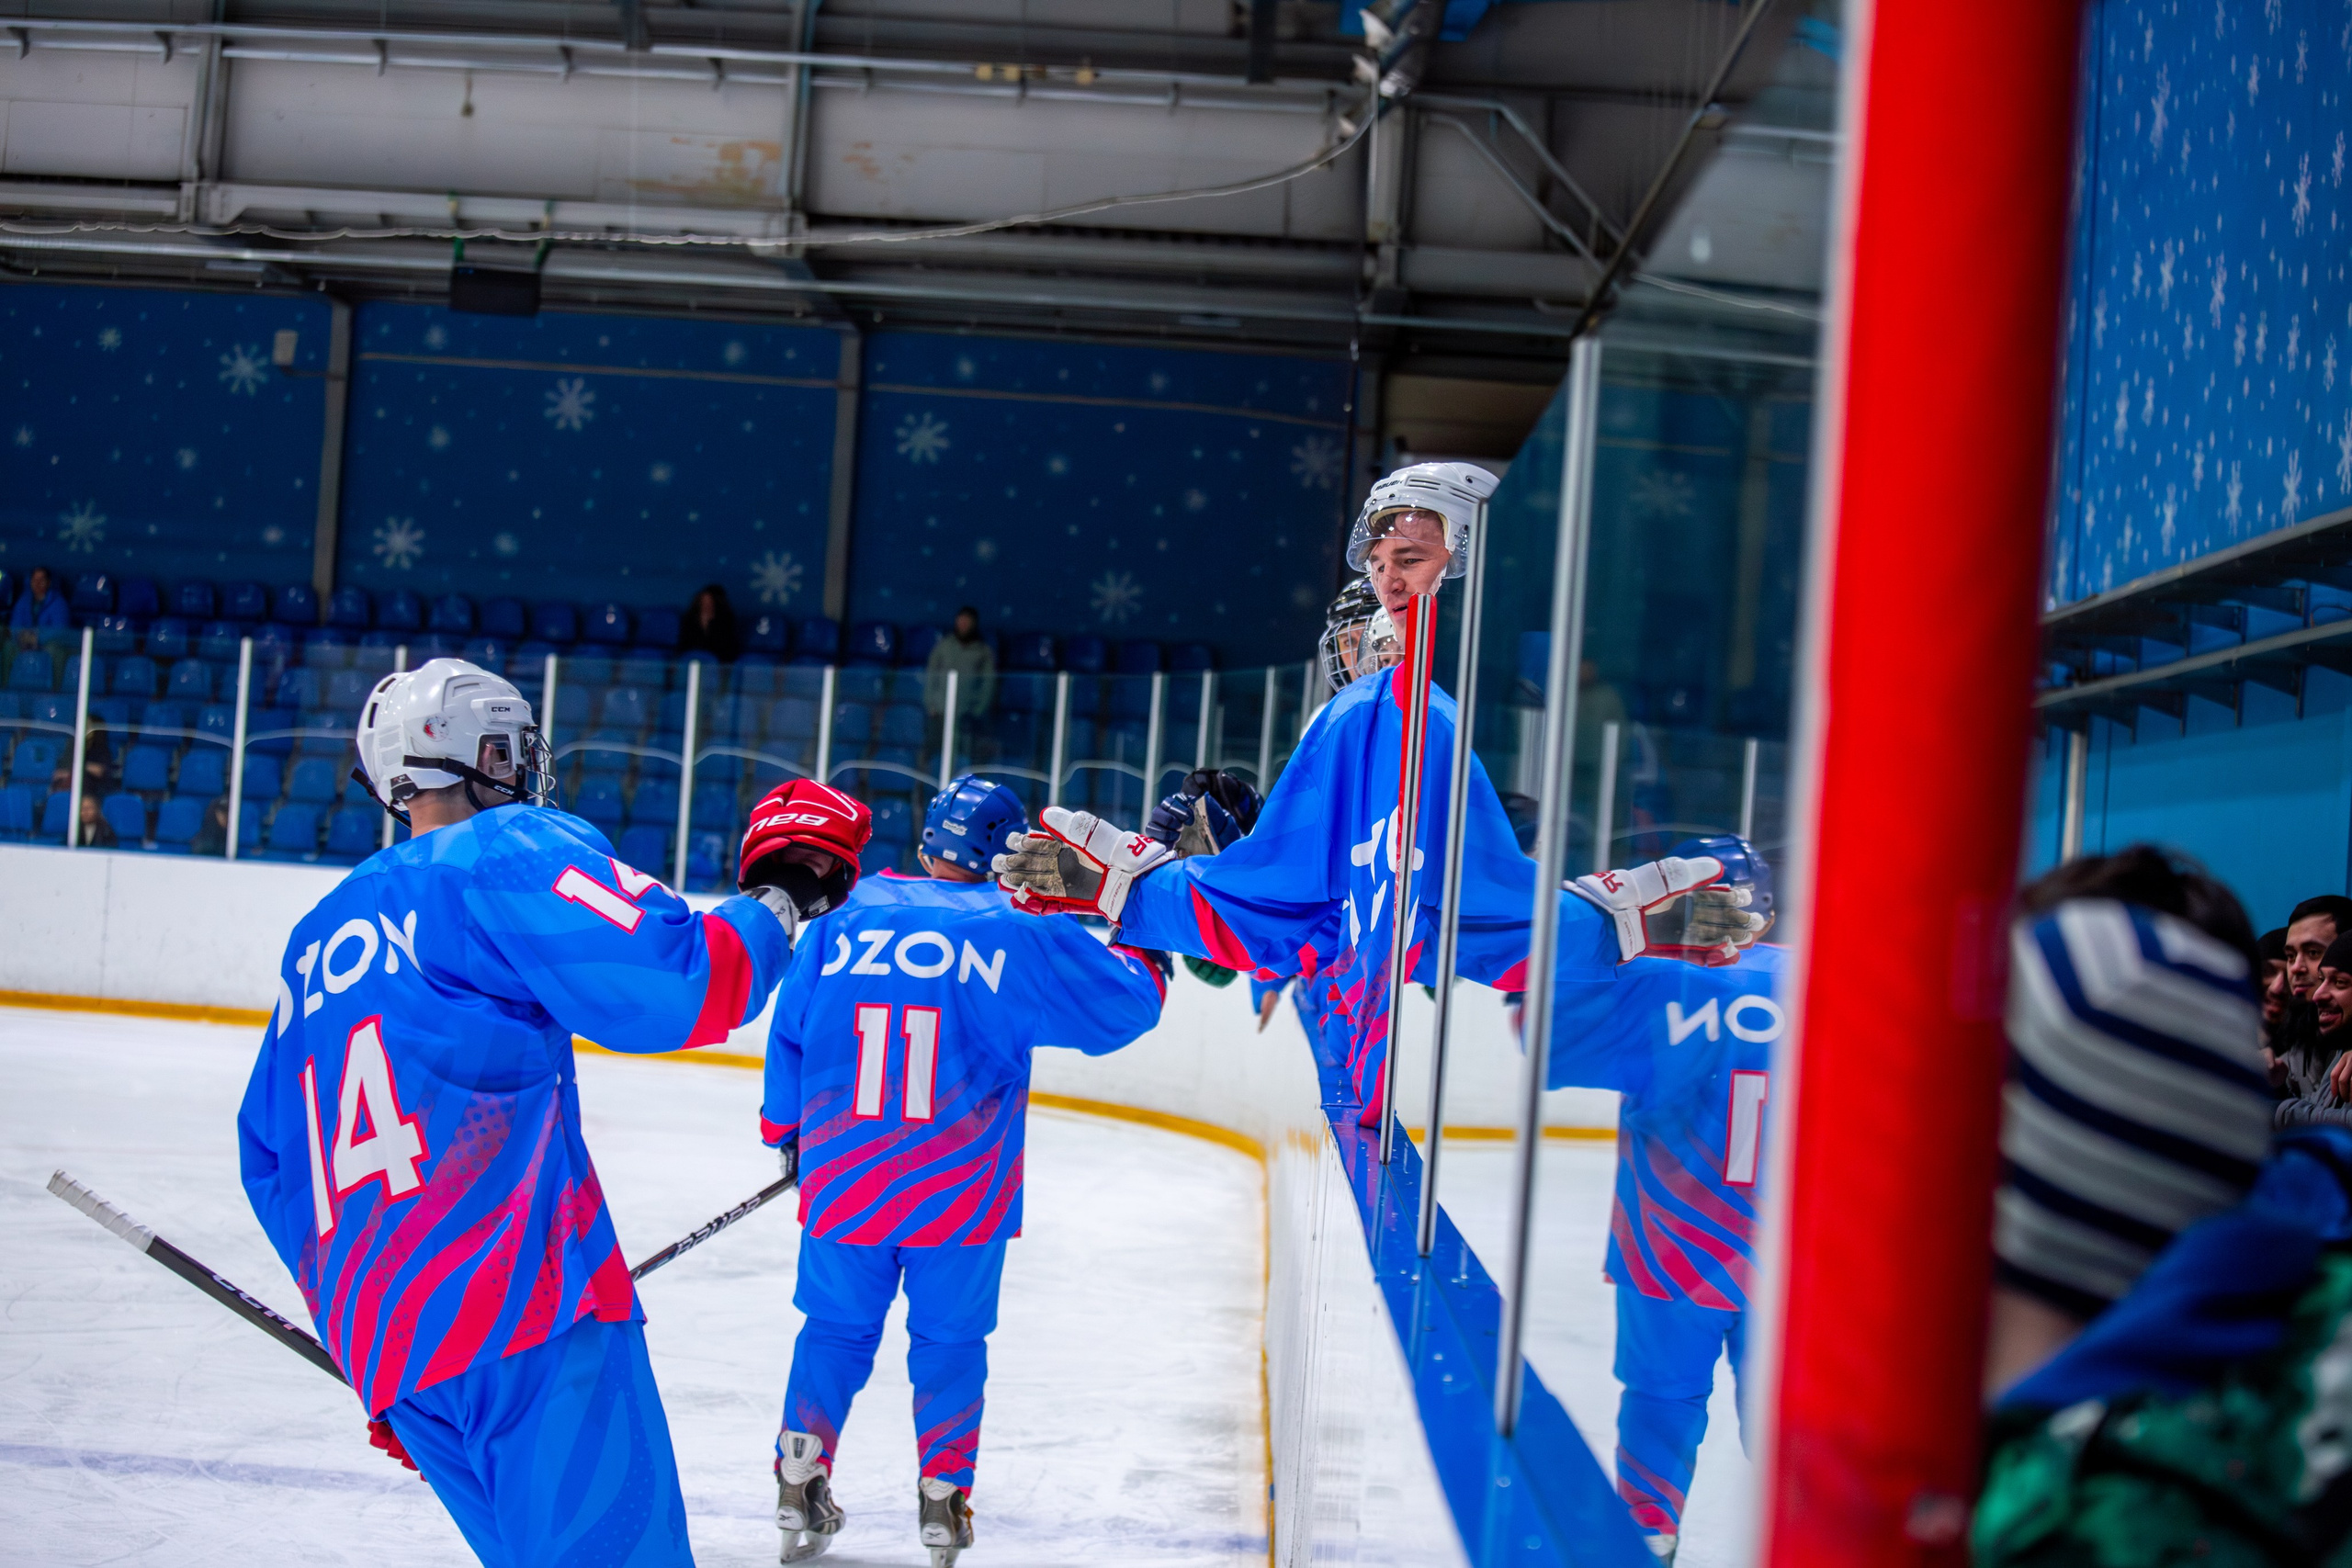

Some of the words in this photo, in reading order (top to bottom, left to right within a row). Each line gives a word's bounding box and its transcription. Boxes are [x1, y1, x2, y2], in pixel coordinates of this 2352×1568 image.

[493, 784, 514, 796] CCM
[852, 1001, 943, 1124] 11
[298, 1013, 432, 1247] 14
